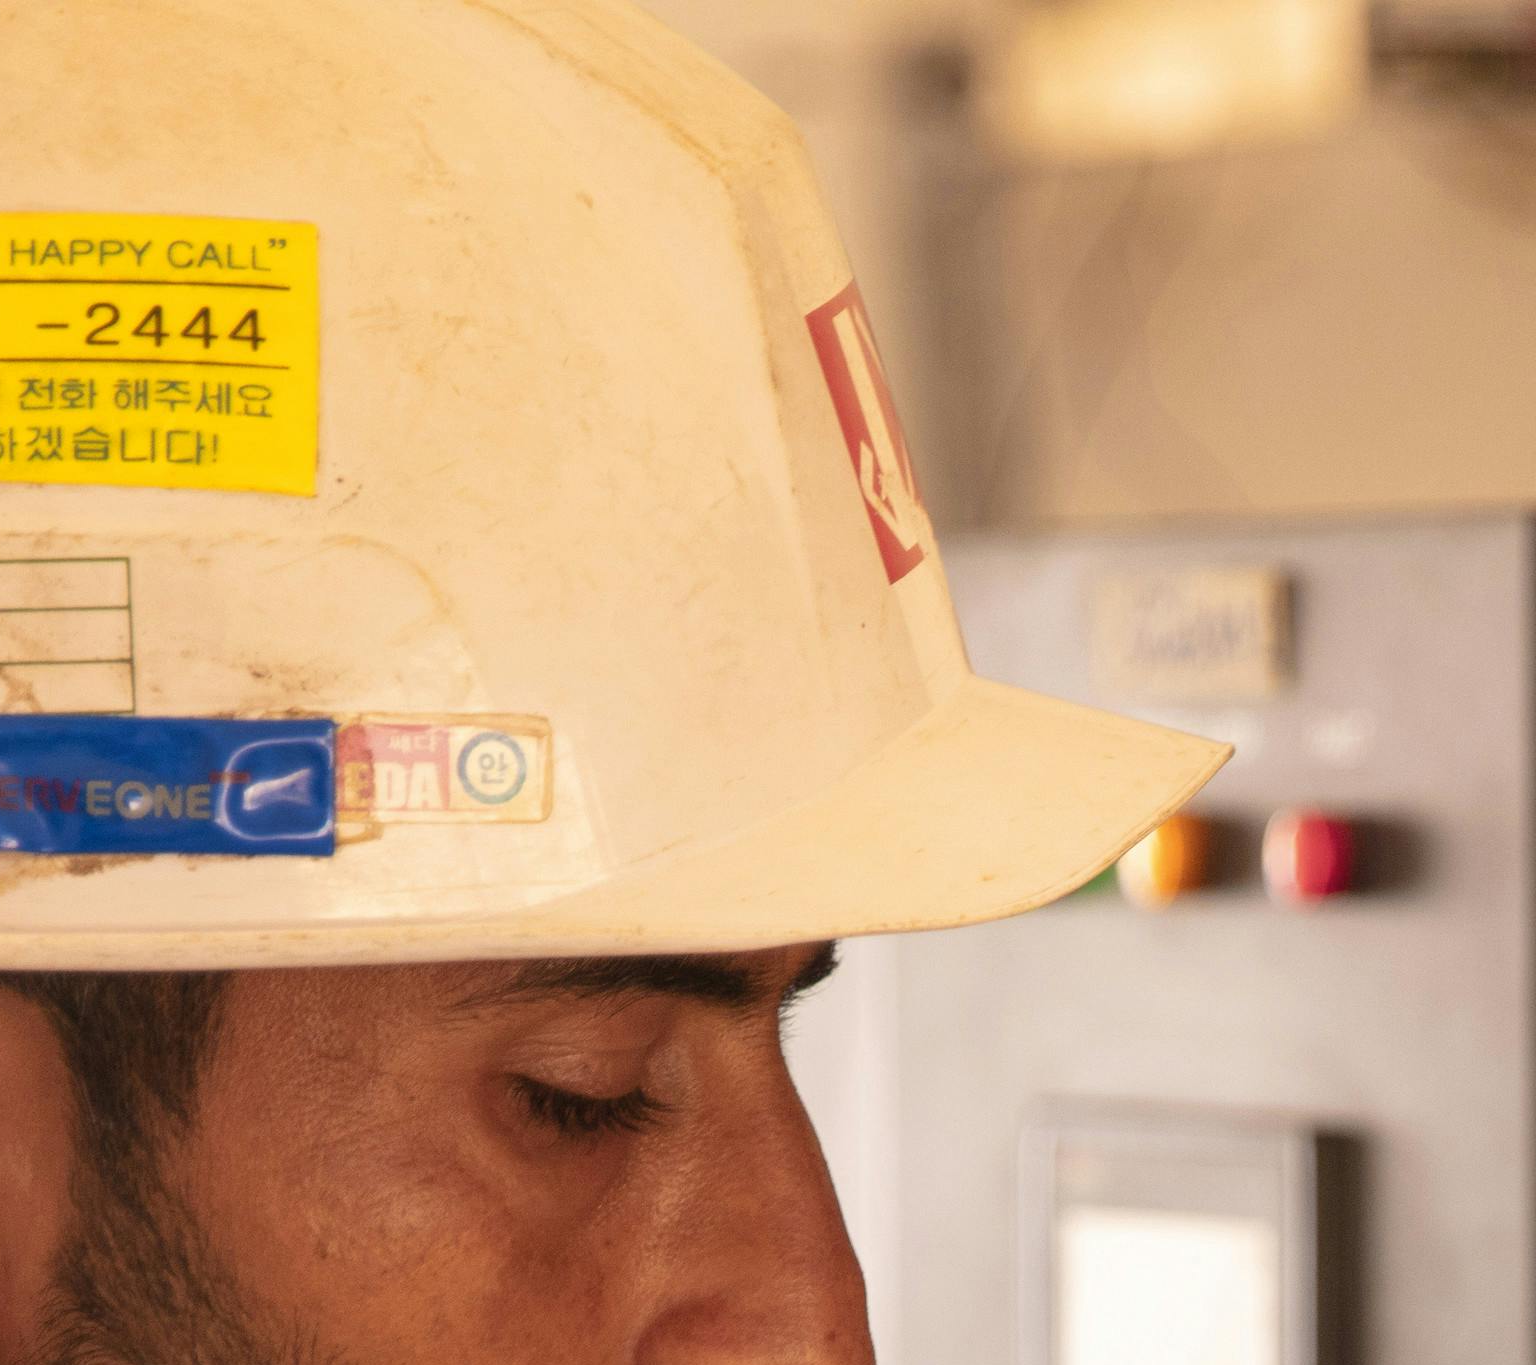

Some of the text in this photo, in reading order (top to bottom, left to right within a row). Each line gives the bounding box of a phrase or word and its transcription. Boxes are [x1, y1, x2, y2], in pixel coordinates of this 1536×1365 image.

[9, 239, 153, 268] HAPPY
[18, 378, 98, 412] 전화
[112, 377, 274, 418] 해주세요
